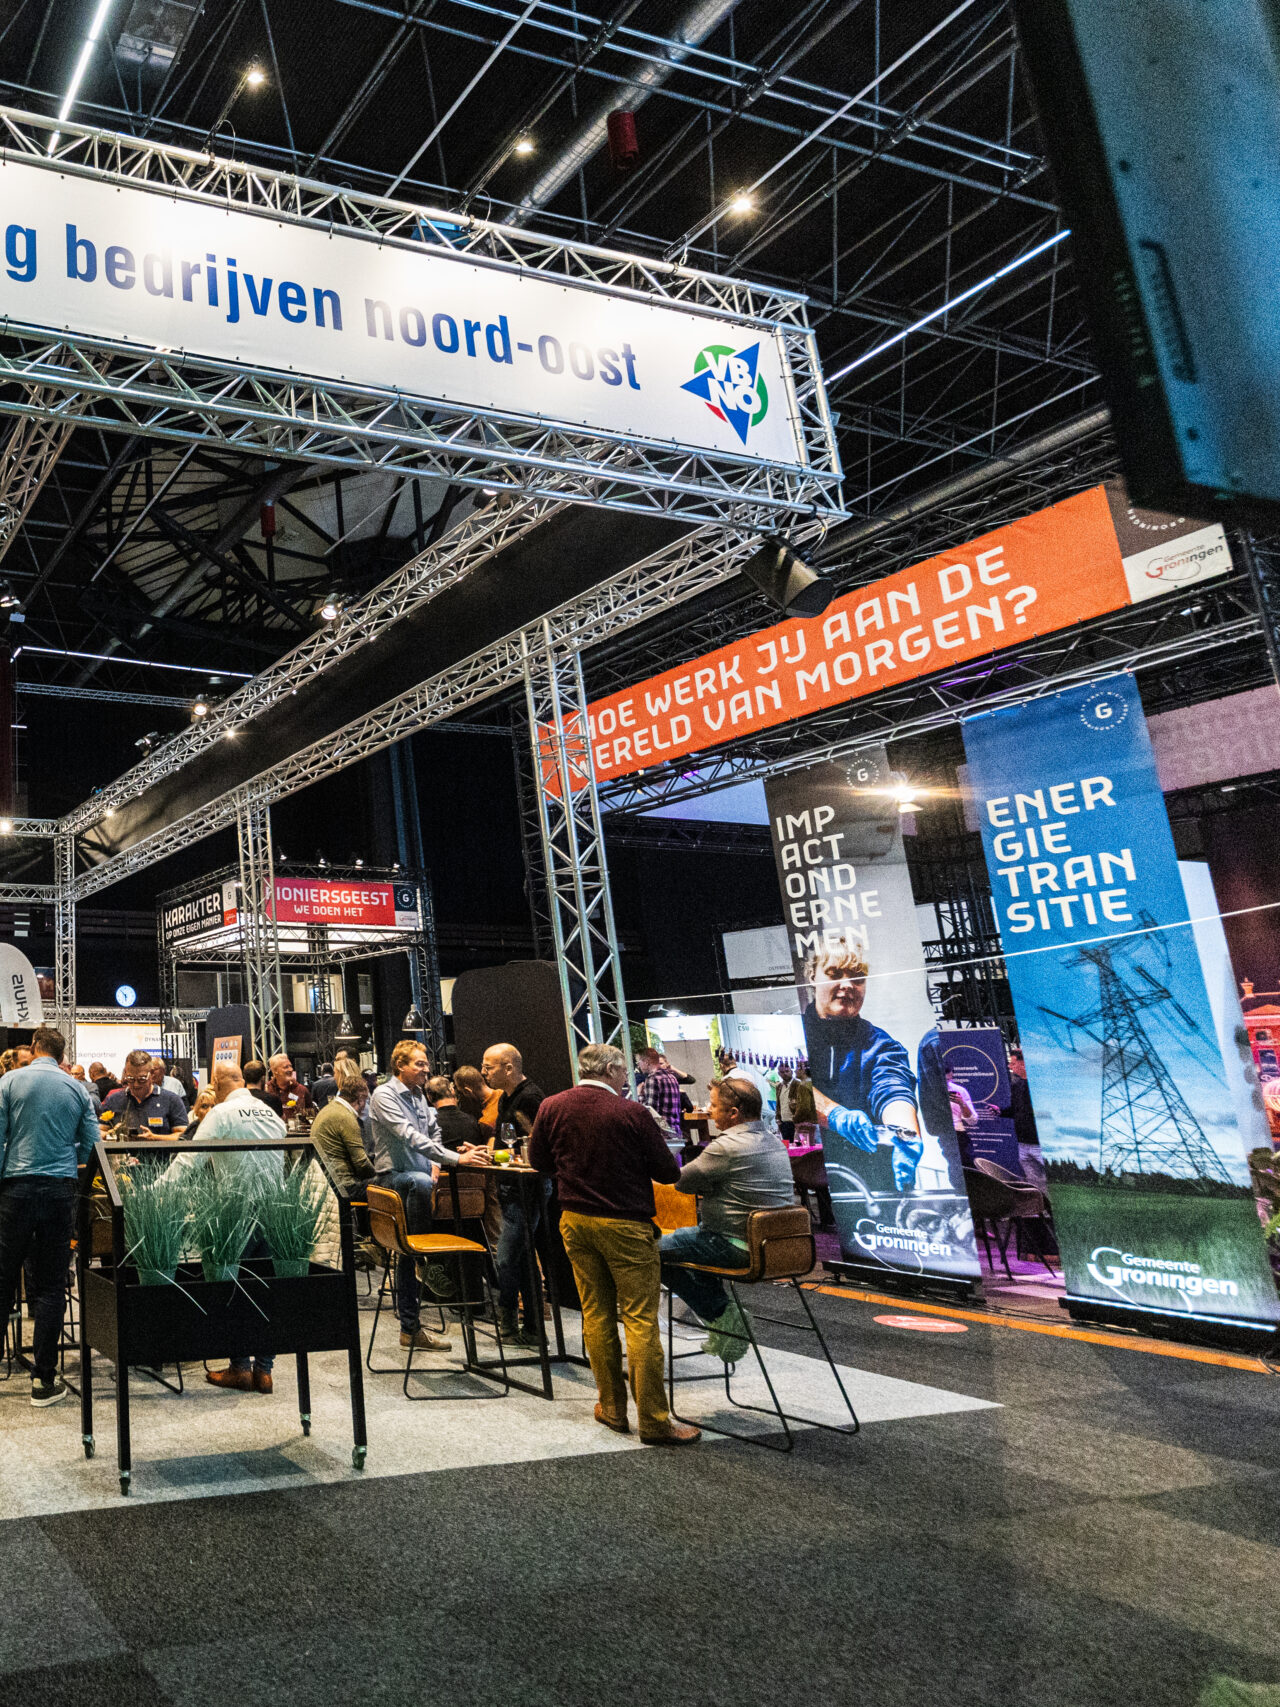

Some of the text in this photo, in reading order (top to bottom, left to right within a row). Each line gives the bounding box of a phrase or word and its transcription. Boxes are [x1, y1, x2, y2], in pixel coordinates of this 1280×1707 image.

[65, 223, 343, 332] bedrijven
[364, 296, 641, 392] noord-oost
[701, 350, 754, 386] VB
[706, 377, 763, 415] NO
[1145, 544, 1225, 579] Groningen
[1163, 543, 1206, 563] Gemeente
[644, 654, 745, 718] WERK
[822, 581, 921, 650] AAN
[937, 545, 1011, 605] DE
[702, 680, 783, 732] VAN
[795, 585, 1038, 702] MORGEN?
[985, 775, 1117, 829] ENER
[775, 805, 836, 842] IMP
[781, 833, 845, 870] ACT
[992, 821, 1074, 864] GIE
[784, 863, 857, 899] OND
[996, 848, 1138, 898] TRAN
[164, 892, 221, 929] KARAKTER
[165, 930, 173, 940] OP
[172, 925, 186, 938] ONZE
[186, 920, 201, 934] EIGEN
[201, 913, 222, 929] MANIER
[293, 904, 364, 918] WE DOEN HET
[789, 889, 883, 929] ERNE
[1006, 888, 1134, 934] SITIE
[793, 924, 871, 959] MEN
[238, 1109, 274, 1118] IVECO
[852, 1230, 952, 1257] Groningen
[875, 1222, 928, 1240] Gemeente
[1086, 1262, 1239, 1297] Groningen
[1120, 1253, 1201, 1274] Gemeente
